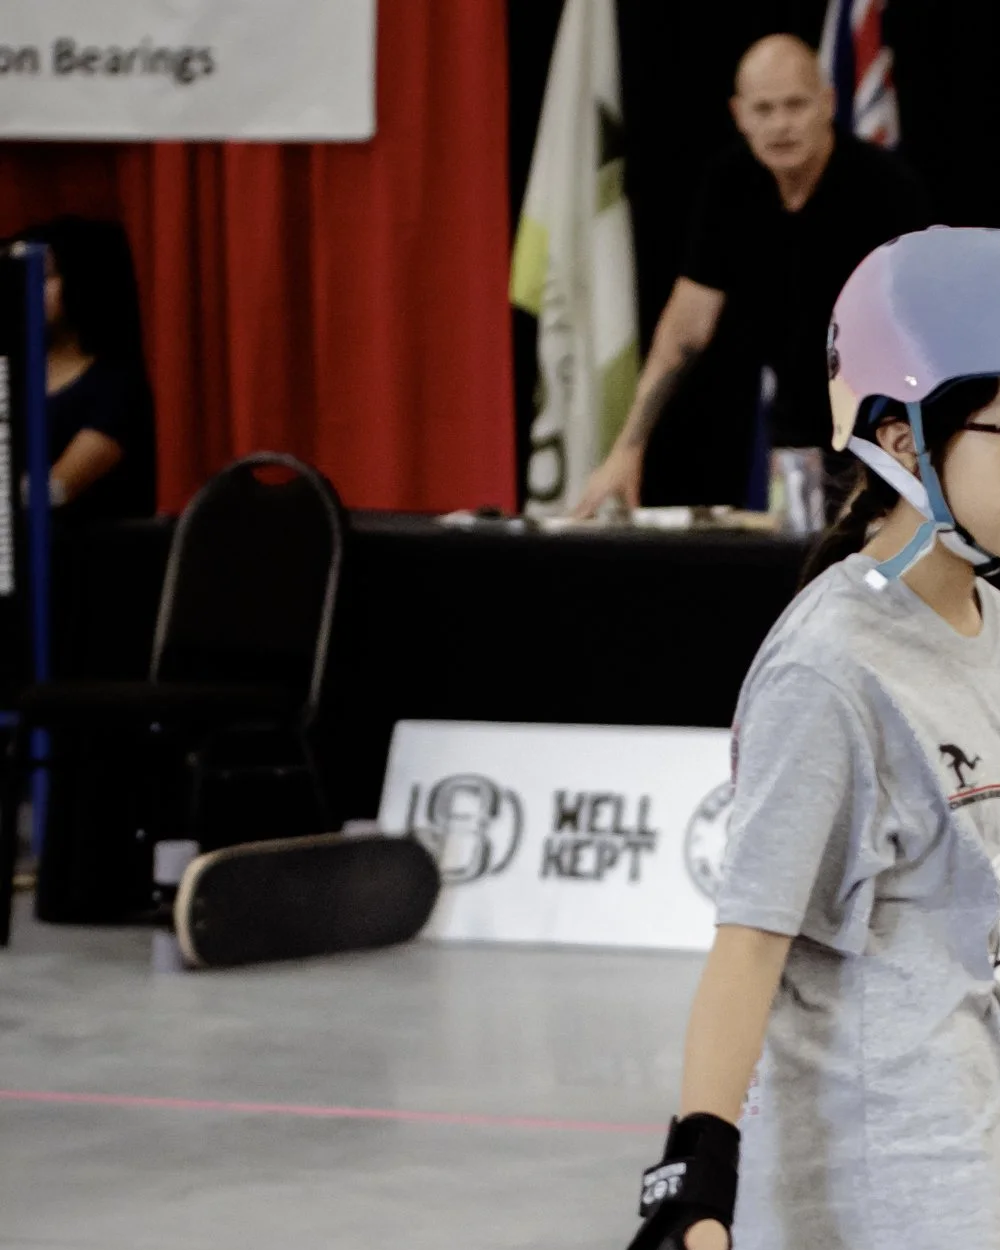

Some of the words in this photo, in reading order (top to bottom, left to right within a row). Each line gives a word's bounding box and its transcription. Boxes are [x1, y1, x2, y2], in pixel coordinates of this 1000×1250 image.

[53, 35, 215, 85] Bearings
[552, 789, 658, 836] WELL
[538, 836, 656, 884] KEPT
